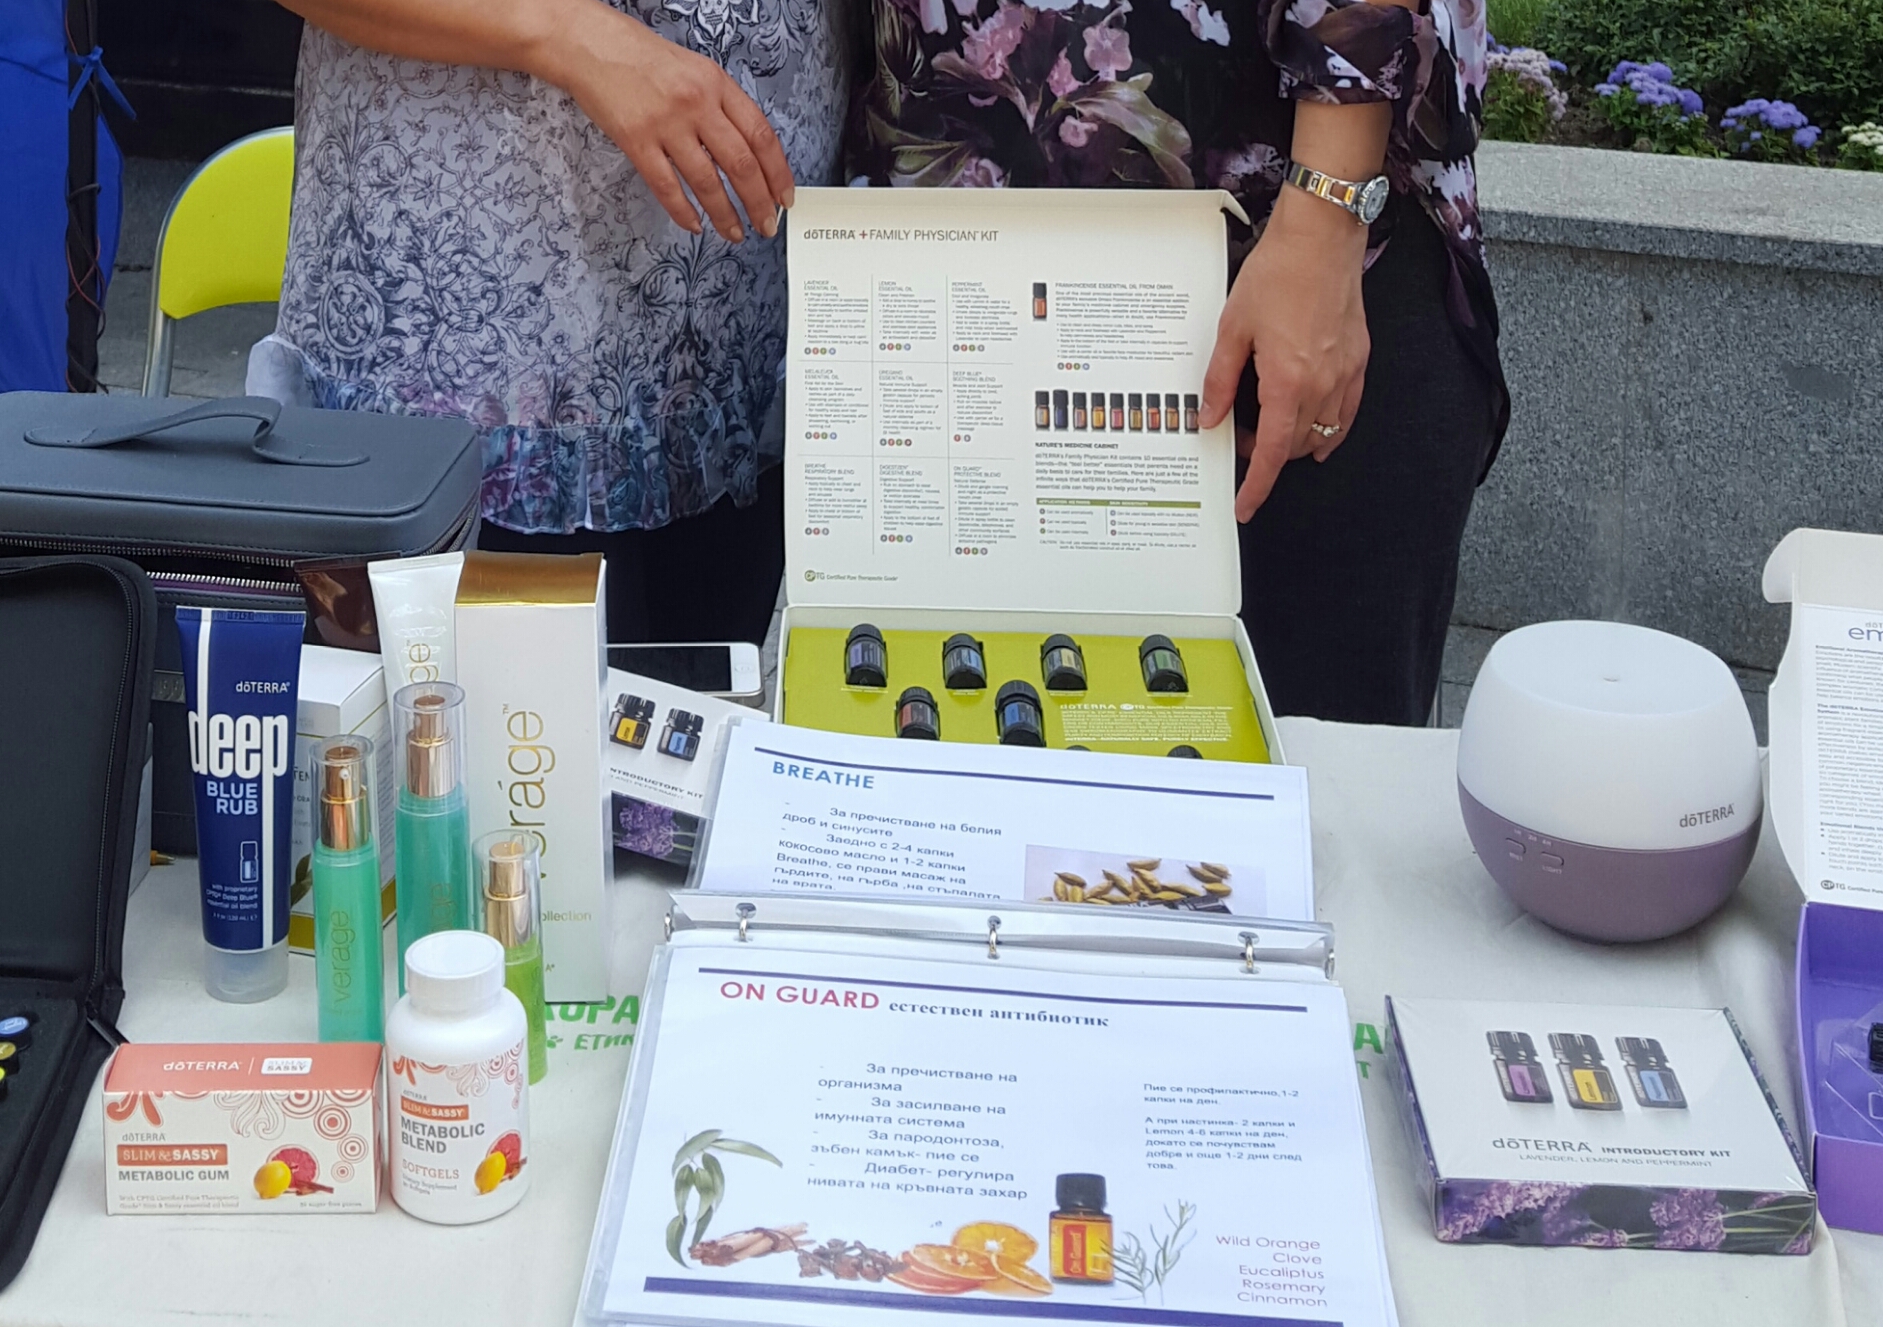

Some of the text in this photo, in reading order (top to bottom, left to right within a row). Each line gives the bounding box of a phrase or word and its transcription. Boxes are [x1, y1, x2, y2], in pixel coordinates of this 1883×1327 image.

[980, 230, 999, 241] KIT
[188, 710, 288, 779] deep
[772, 761, 875, 789] BREATHE
[207, 781, 258, 799] BLUE
[687, 789, 704, 799] KIT
[216, 799, 258, 815] RUB
[782, 812, 893, 837] дроб и синусите
[829, 807, 1002, 836] За пречистване на белия
[826, 834, 876, 849] Заедно
[891, 842, 912, 853] 2-4
[916, 847, 955, 859] капки
[778, 840, 966, 873] кокосово масло и 1-2 капки
[772, 877, 787, 885] на
[836, 862, 852, 870] се
[856, 865, 897, 877] прави
[901, 871, 946, 883] масаж
[950, 876, 966, 885] на
[837, 874, 854, 883] на
[539, 911, 592, 922] ollection
[330, 909, 356, 1003] verage
[720, 981, 1109, 1027] ON GUARD естествен антибиотик
[266, 1064, 306, 1072] SASSY
[866, 1063, 1018, 1082] За пречистване на
[818, 1077, 903, 1092] организма
[1144, 1084, 1167, 1092] Пие
[871, 1096, 1006, 1115] За засилване на
[1144, 1096, 1176, 1104] капки
[431, 1107, 463, 1117] SASSY
[814, 1111, 965, 1129] имунната система
[401, 1116, 485, 1139] METABOLIC
[1145, 1128, 1184, 1136] Lemon
[401, 1133, 447, 1154] BLEND
[868, 1130, 1004, 1149] За пародонтоза,
[1146, 1139, 1186, 1148] докато
[1207, 1141, 1276, 1150] почувствам
[122, 1148, 157, 1161] SLIM
[173, 1148, 219, 1161] SASSY
[811, 1144, 860, 1155] зъбен
[926, 1151, 956, 1161] пие
[961, 1154, 980, 1162] се
[1146, 1150, 1182, 1159] добре
[1197, 1151, 1222, 1160] още
[1247, 1153, 1269, 1161] дни
[1273, 1154, 1302, 1162] след
[1601, 1146, 1706, 1158] INTRODUCTORY
[1710, 1148, 1731, 1158] KIT
[402, 1159, 460, 1179] SOFTGELS
[1580, 1156, 1618, 1165] LEMON
[1622, 1157, 1644, 1166] AND
[1646, 1159, 1713, 1168] PEPPERMINT
[118, 1170, 230, 1181] METABOLIC GUM
[937, 1168, 1014, 1183] регулира
[807, 1176, 1028, 1200] нивата на кръвната захар
[1216, 1235, 1320, 1252] Wild Orange
[1272, 1252, 1322, 1265] Clove
[1238, 1264, 1325, 1280] Eucaliptus
[1242, 1278, 1326, 1295] Rosemary
[1237, 1291, 1327, 1308] Cinnamon
